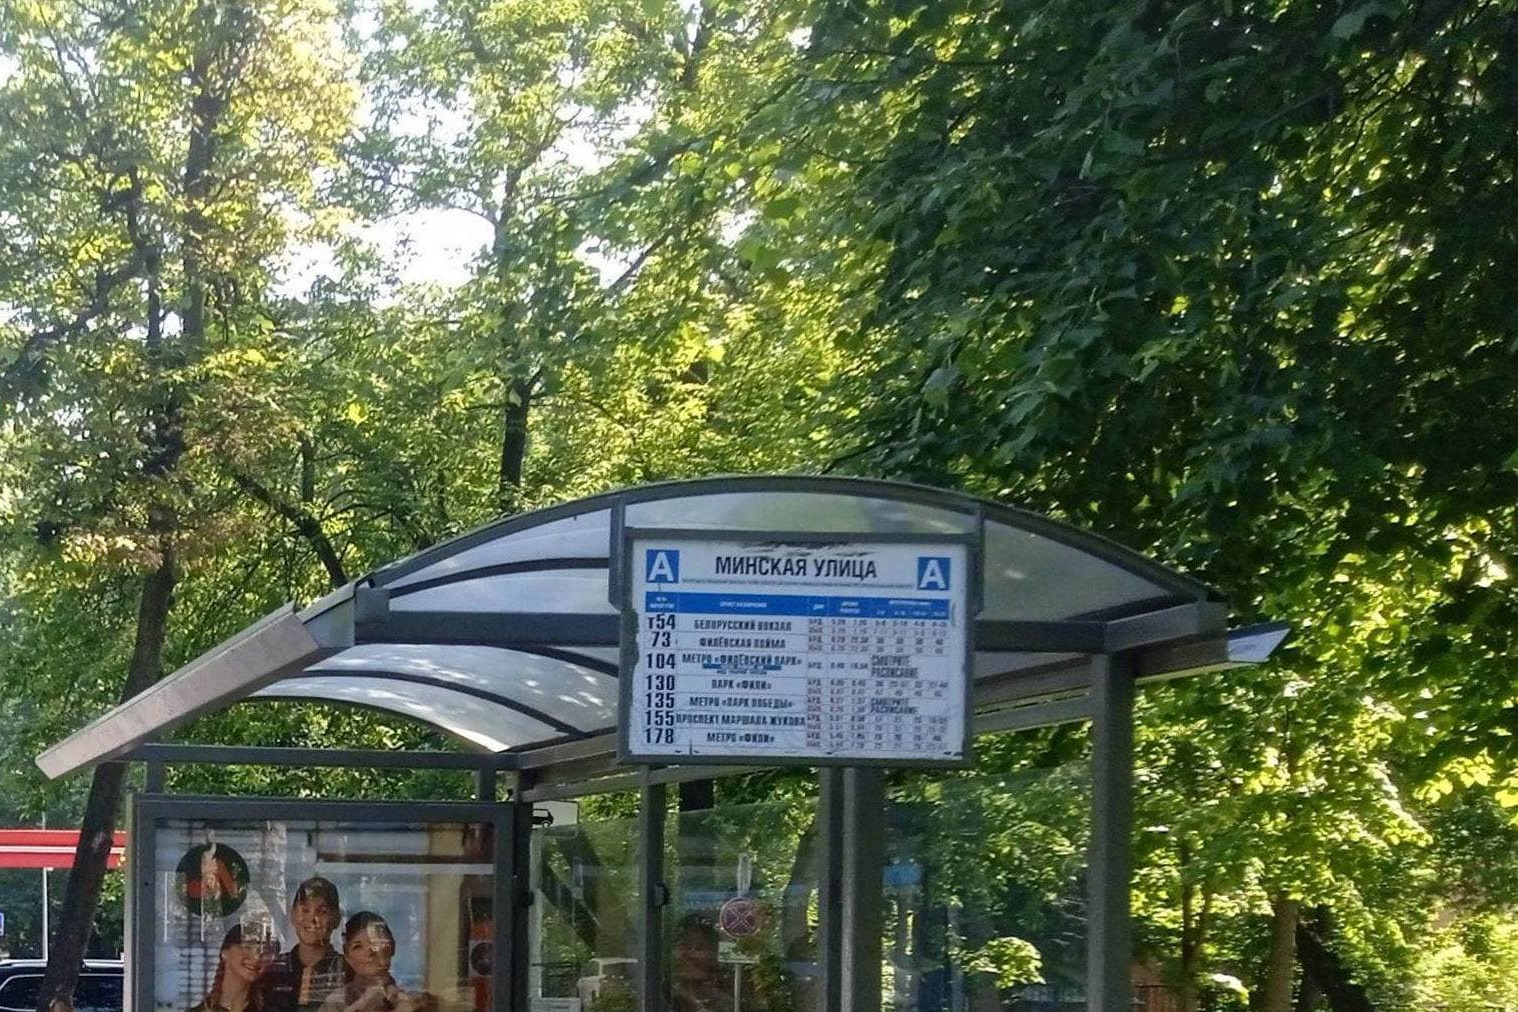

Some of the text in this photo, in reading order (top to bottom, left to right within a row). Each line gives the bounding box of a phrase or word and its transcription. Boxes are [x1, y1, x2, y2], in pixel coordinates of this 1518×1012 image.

[714, 556, 877, 581] МИНСКАЯ УЛИЦА
[694, 619, 792, 632] БЕЛОРУССКИЙ ВОКЗАЛ
[651, 631, 671, 648] 73
[754, 637, 786, 648] ПОЙМА
[646, 653, 676, 669] 104
[682, 653, 712, 664] МЕТРО
[646, 675, 675, 691] 130
[711, 679, 734, 690] ПАРК
[645, 692, 675, 708] 135
[689, 697, 720, 707] МЕТРО
[645, 710, 675, 726] 155
[676, 713, 719, 725] ПРОСПЕКТ
[721, 714, 768, 725] МАРШАЛА
[769, 715, 806, 726] ЖУКОВА
[644, 728, 675, 744] 178
[707, 732, 737, 743] МЕТРО
